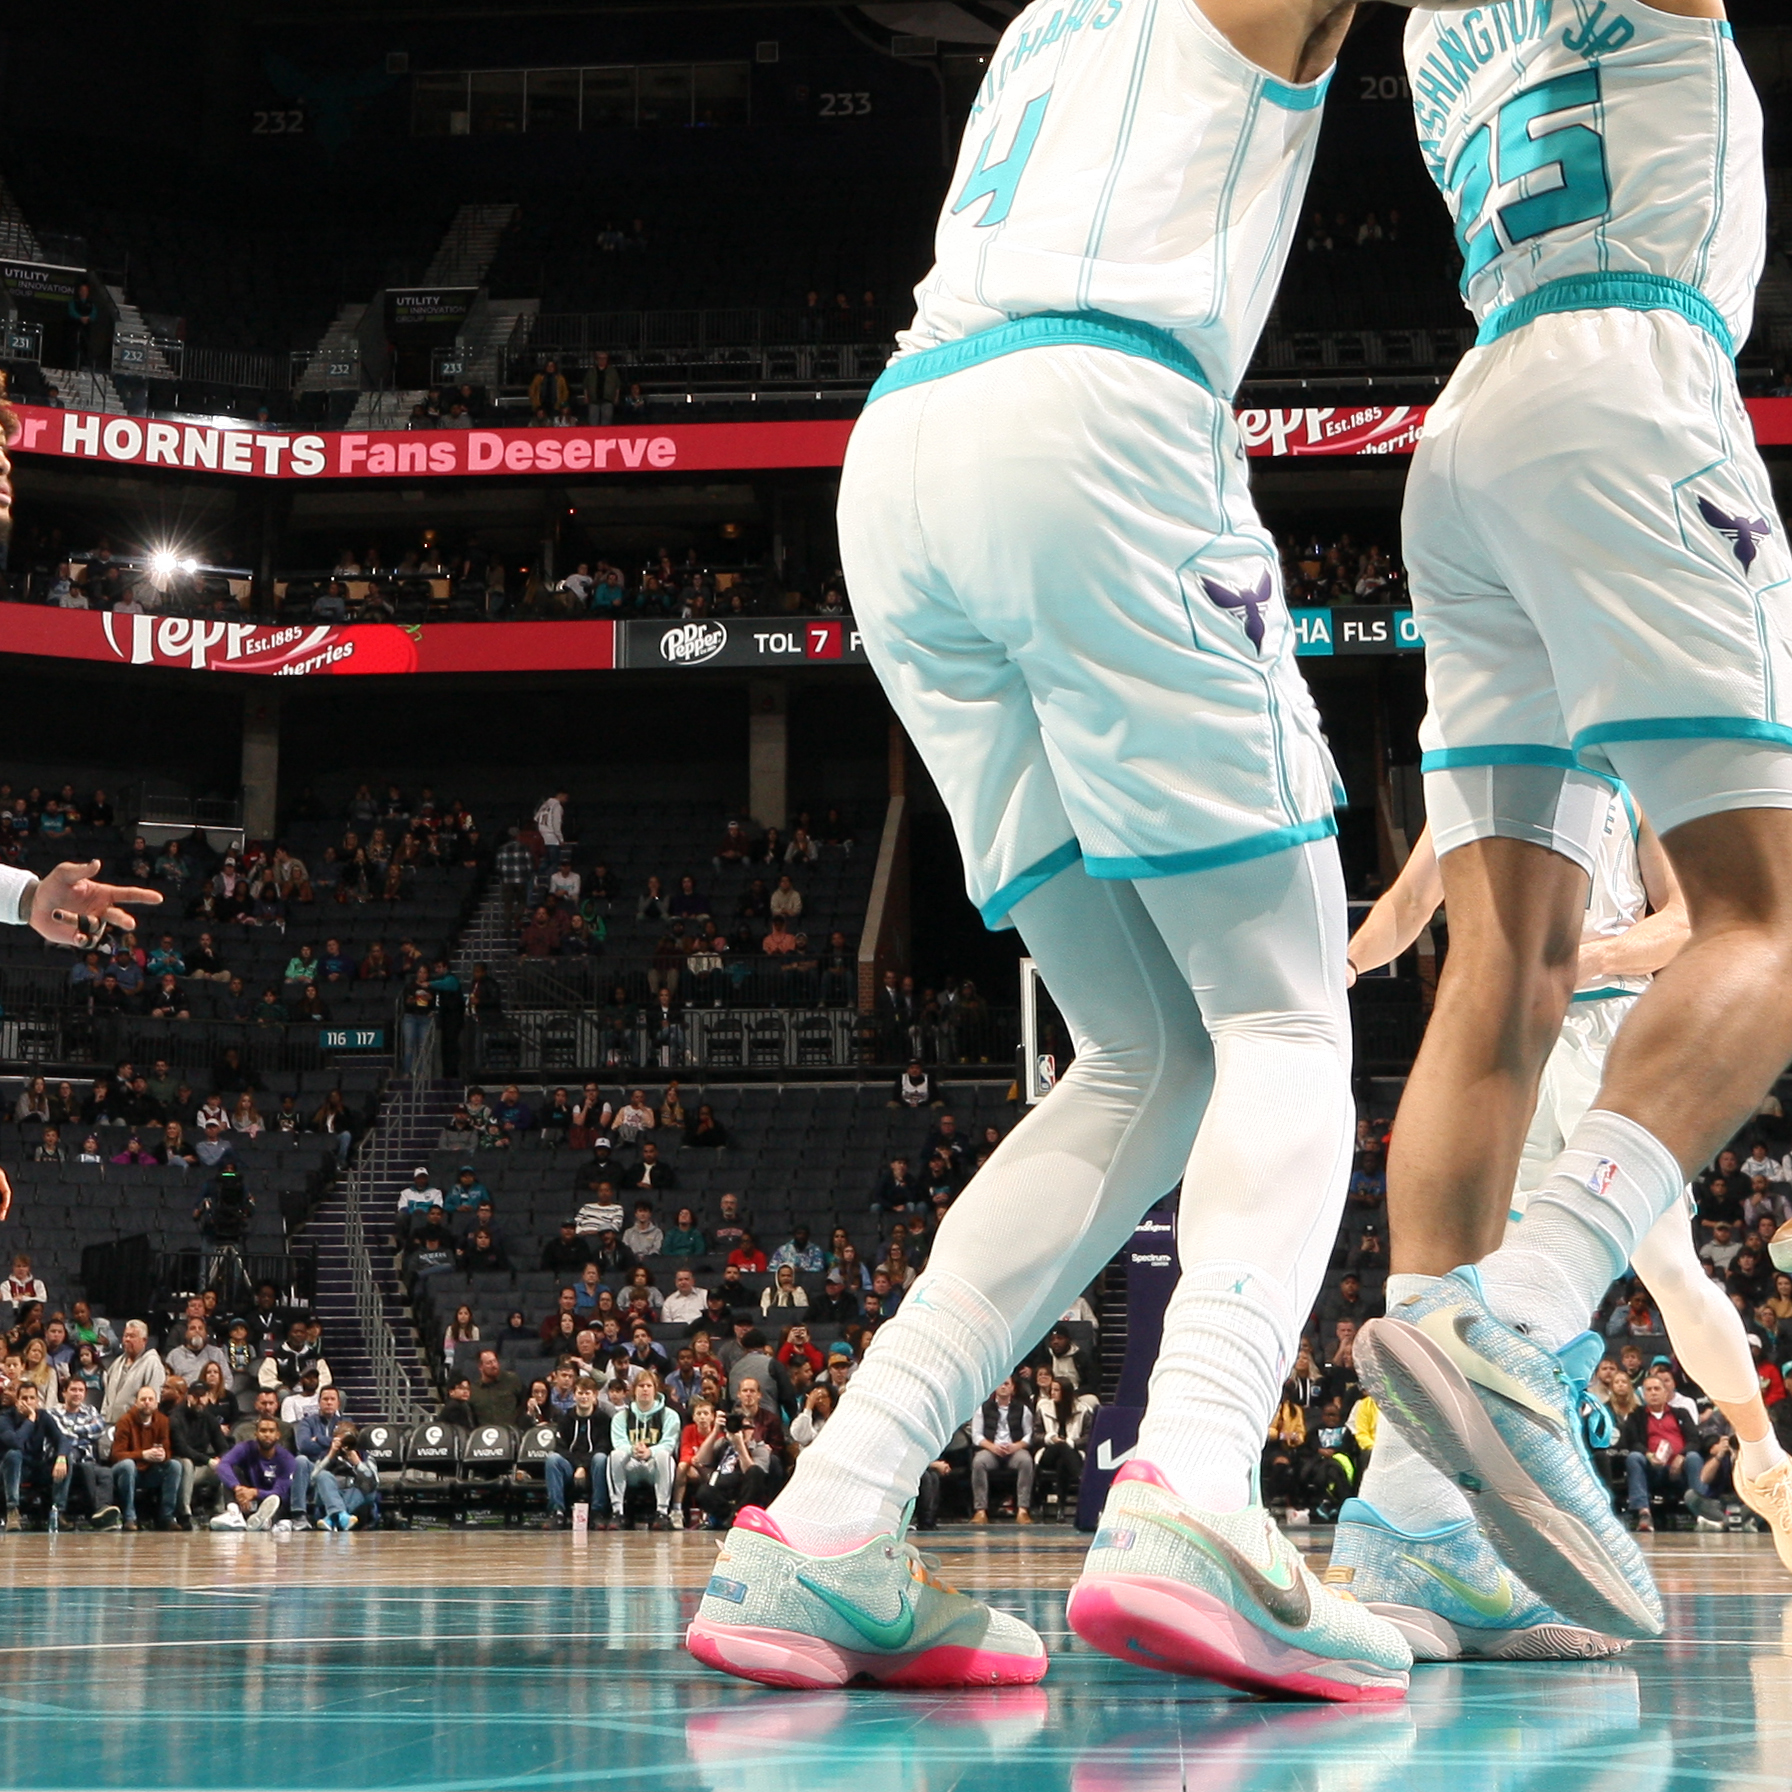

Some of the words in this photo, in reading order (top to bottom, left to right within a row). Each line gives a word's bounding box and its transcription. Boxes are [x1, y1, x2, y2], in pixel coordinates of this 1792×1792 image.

[819, 92, 872, 116] 233
[253, 110, 304, 134] 232
[949, 88, 1053, 228] 4
[1452, 66, 1612, 302] 25
[4, 267, 49, 282] UTILITY
[17, 280, 75, 296] INNOVATION
[395, 296, 440, 306] UTILITY
[409, 305, 467, 315] INNOVATION
[12, 336, 30, 349] 231
[124, 350, 143, 363] 232
[330, 363, 350, 375] 232
[442, 362, 462, 375] 233
[62, 413, 326, 476] HORNETS
[339, 432, 458, 474] Fans
[468, 430, 677, 472] Deserve
[683, 623, 707, 644] Dr
[1343, 621, 1388, 642] FLS
[245, 626, 303, 655] Est.1885
[668, 629, 722, 662] Pepper
[753, 633, 802, 653] TOL
[811, 630, 829, 653] 7
[327, 1032, 347, 1046] 116
[356, 1032, 376, 1046] 117
[417, 1447, 448, 1457] wave
[472, 1447, 504, 1457] wave
